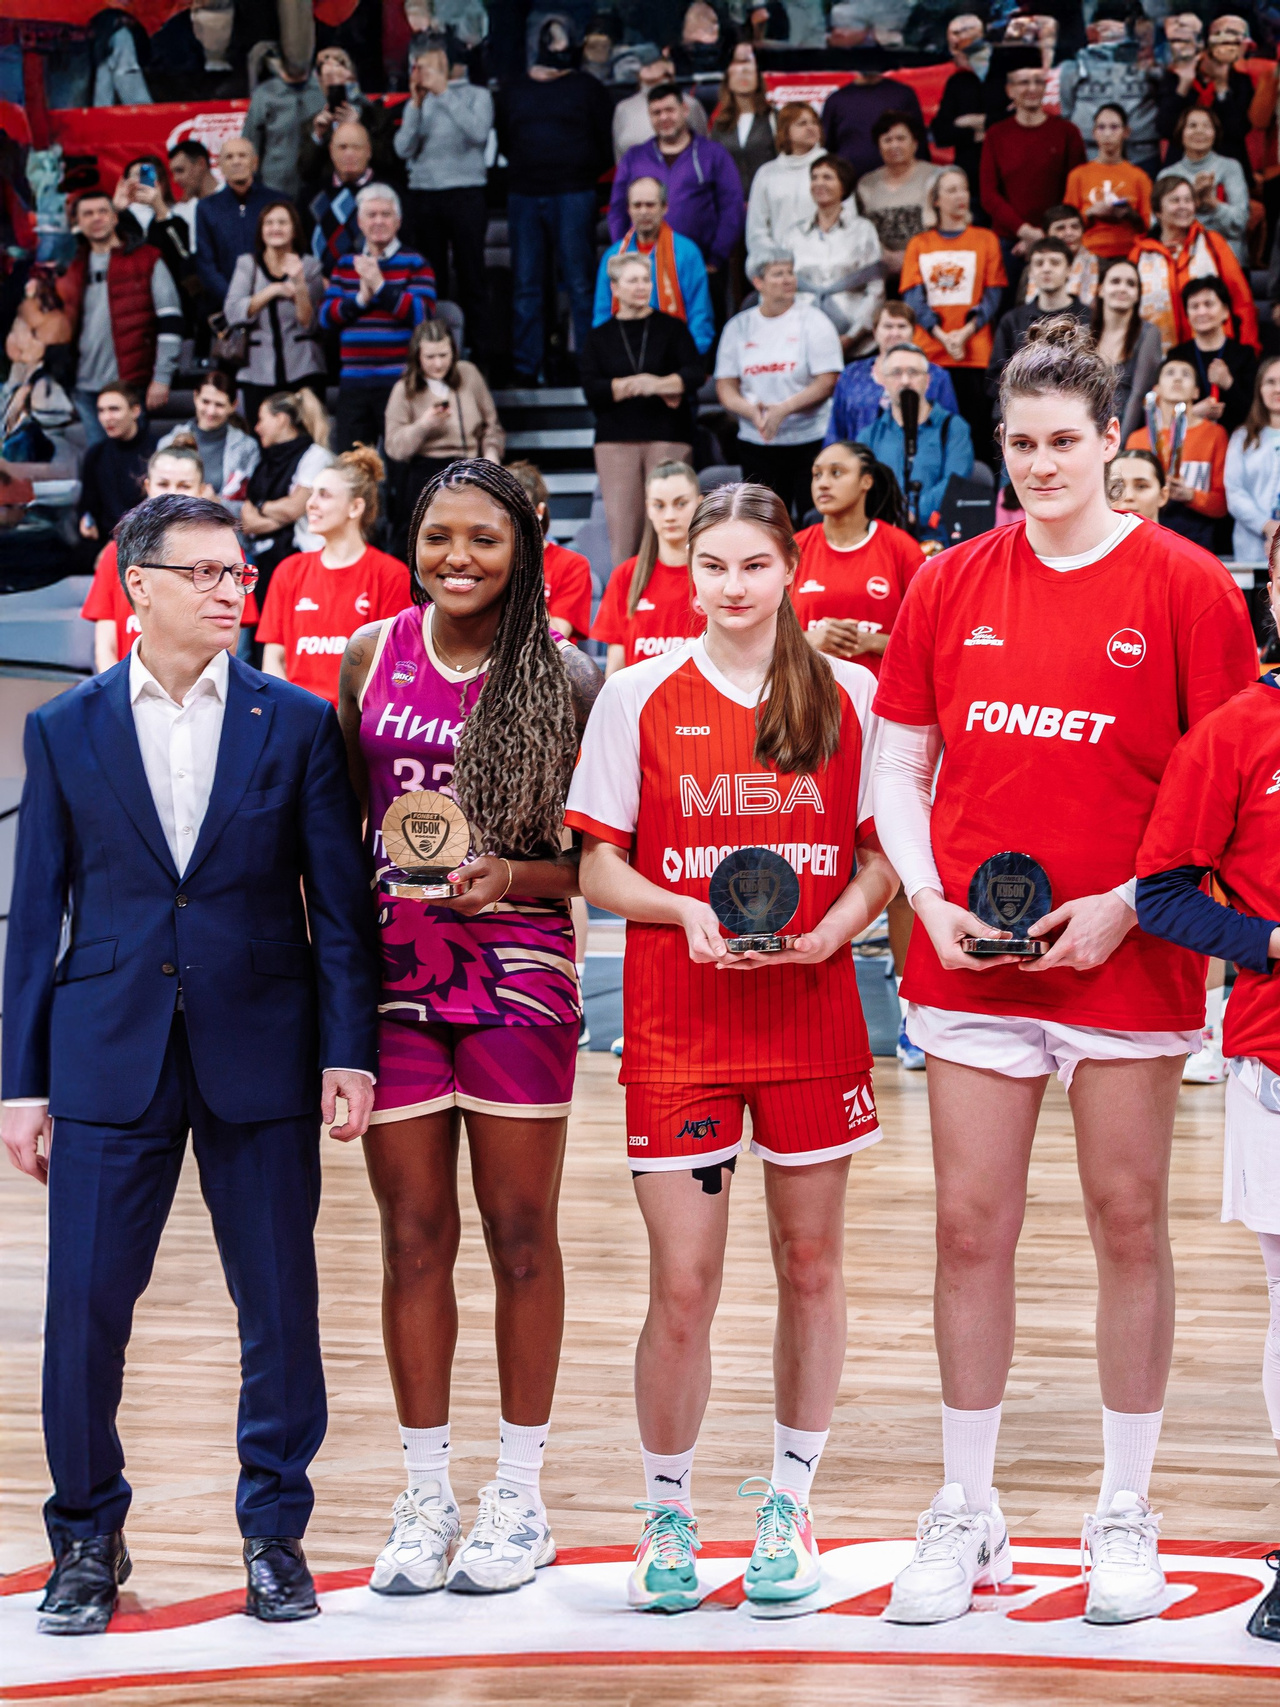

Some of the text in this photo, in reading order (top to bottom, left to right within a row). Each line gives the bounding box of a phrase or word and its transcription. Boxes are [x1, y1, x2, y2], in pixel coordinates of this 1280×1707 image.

[296, 636, 347, 655] FONB
[634, 637, 700, 656] FONBE
[1112, 641, 1142, 656] РФБ
[375, 702, 464, 748] Ник
[675, 725, 711, 736] ZEDO
[965, 701, 1116, 744] FONBET
[680, 773, 825, 817] МБА
[411, 821, 440, 835] КУБОК
[628, 1135, 649, 1147] ZEDO
